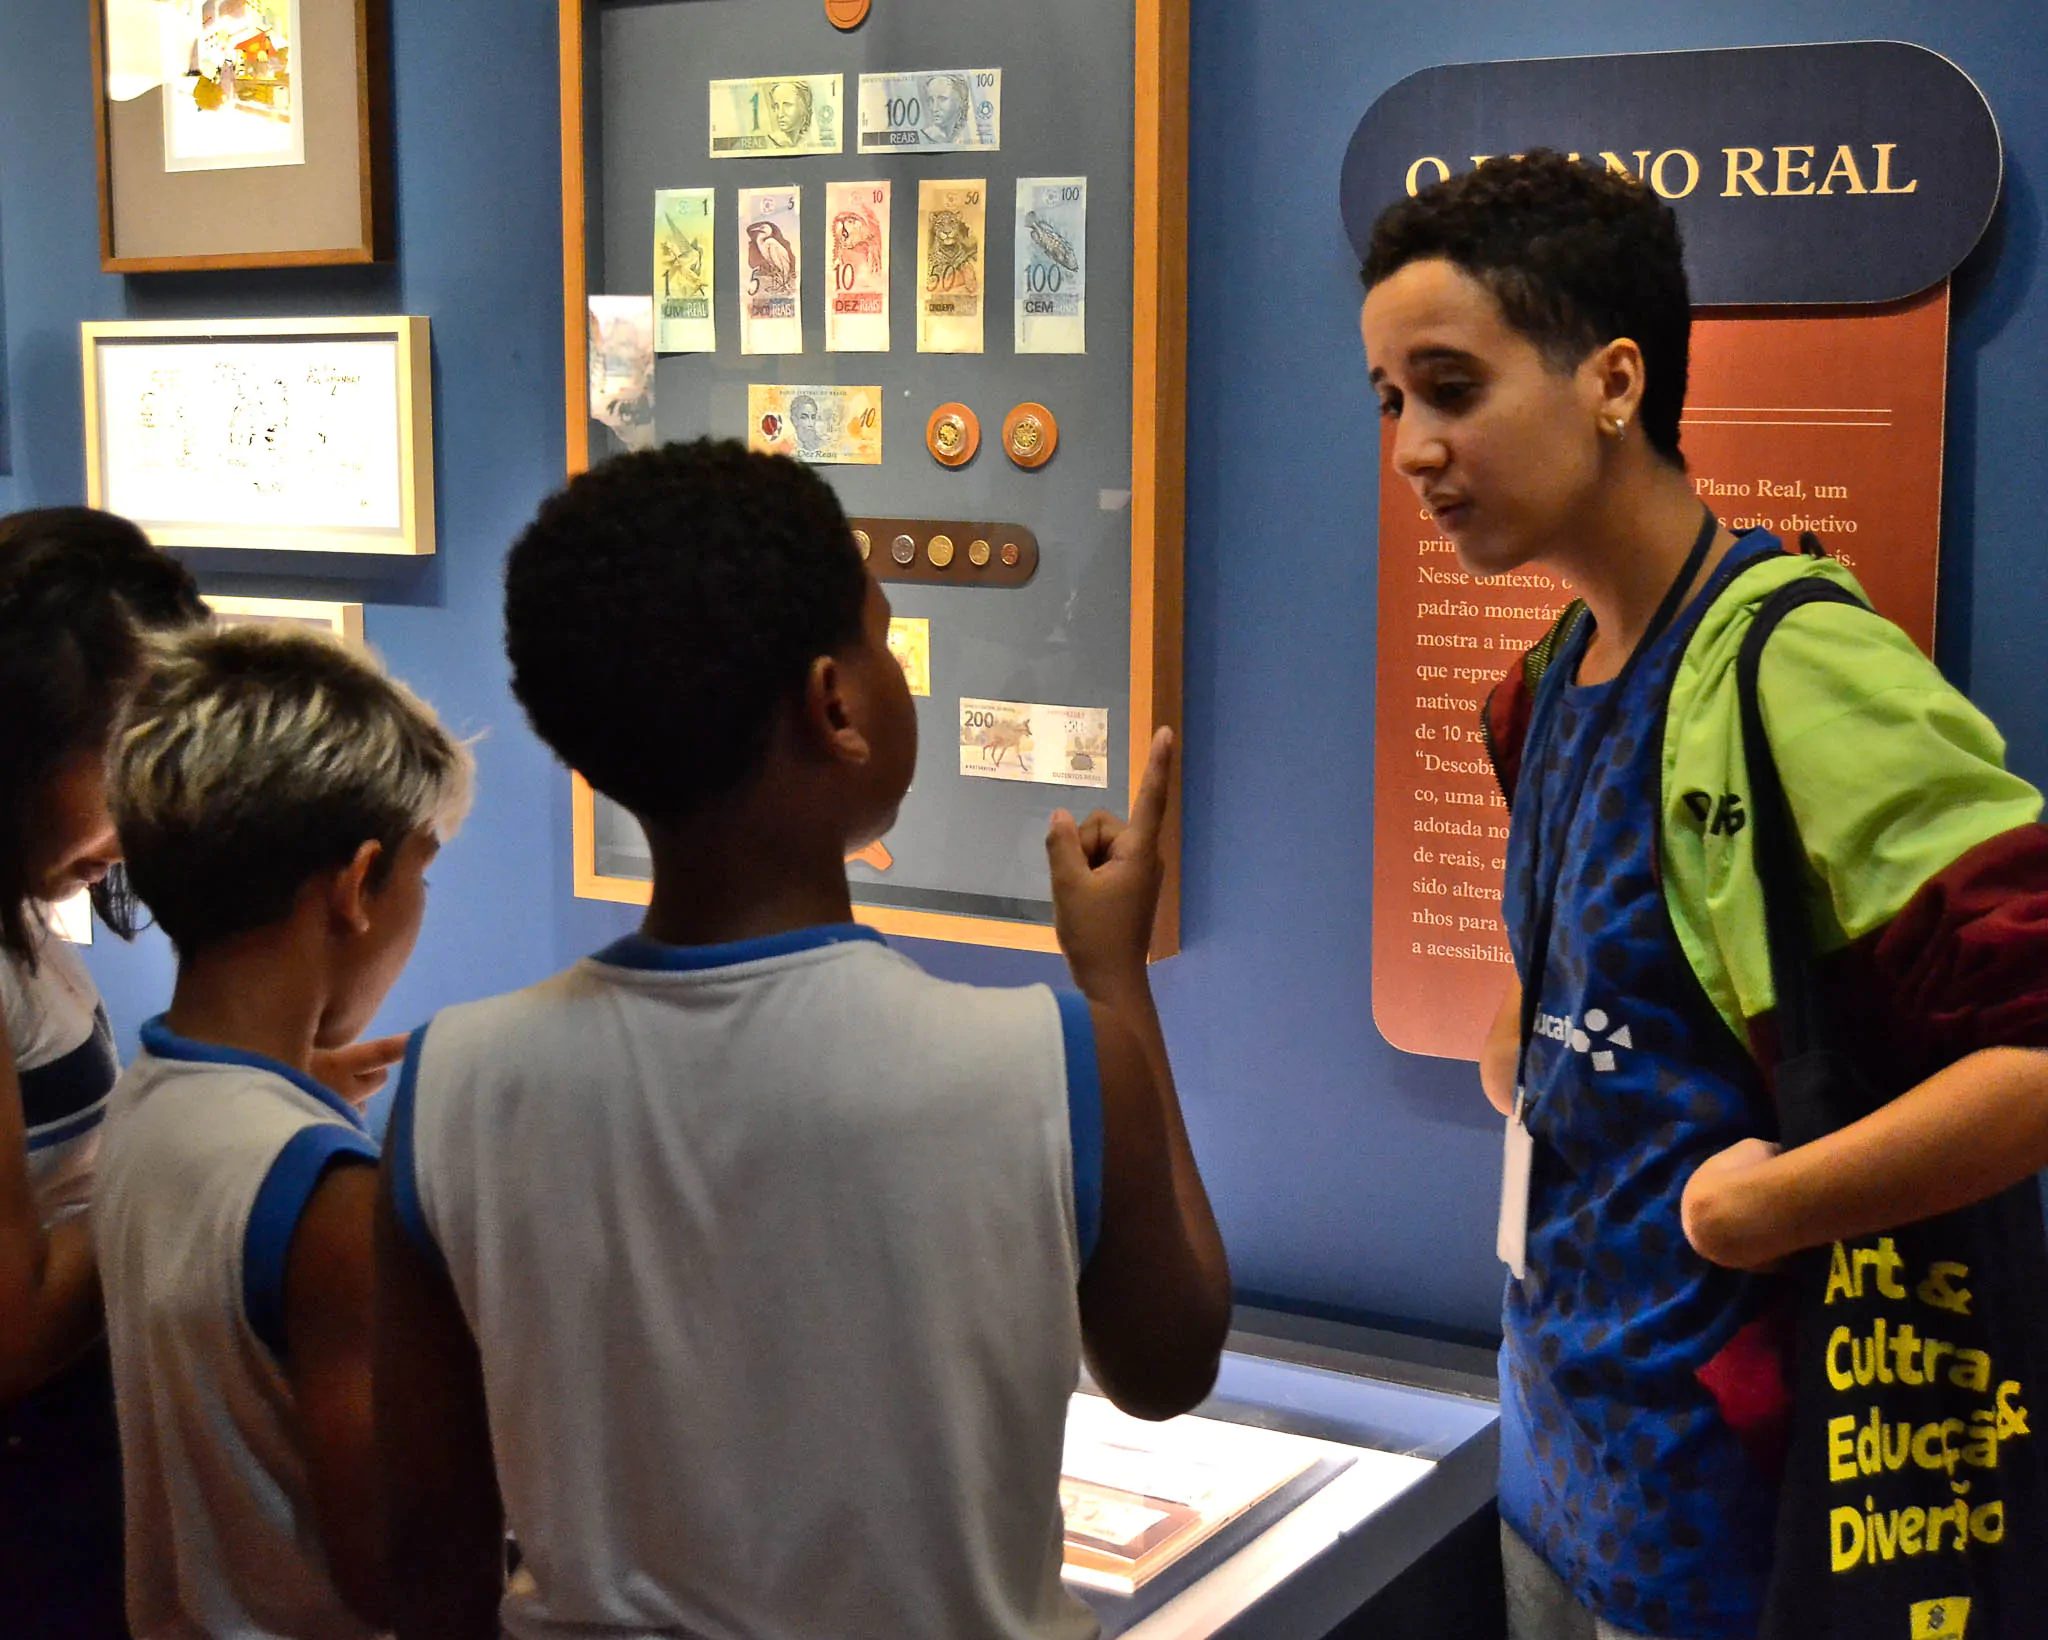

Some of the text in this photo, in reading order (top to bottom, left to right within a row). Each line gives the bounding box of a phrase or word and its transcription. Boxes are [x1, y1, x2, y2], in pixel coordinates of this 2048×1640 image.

[976, 73, 994, 88] 100
[749, 92, 760, 131] 1
[885, 97, 920, 127] 100
[889, 134, 916, 144] REAIS
[1719, 143, 1918, 197] REAL
[872, 190, 884, 204] 10
[964, 191, 980, 205] 50
[1061, 186, 1080, 201] 100
[833, 263, 855, 291] 10
[926, 263, 957, 293] 50
[1023, 263, 1062, 293] 100
[835, 300, 859, 311] DEZ
[1025, 300, 1054, 313] CEM
[859, 407, 876, 428] 10
[1695, 477, 1849, 501] Plano Real, um
[1418, 566, 1469, 585] Nesse
[1416, 599, 1479, 619] padrão
[1416, 633, 1478, 648] mostra
[1483, 637, 1494, 650] a
[1416, 664, 1449, 681] que
[1415, 693, 1478, 712] nativos
[963, 709, 994, 729] 200
[1415, 723, 1437, 740] de
[1442, 725, 1462, 742] 10
[1414, 788, 1439, 805] co,
[1444, 792, 1485, 806] uma
[1413, 817, 1483, 837] adotada
[1413, 846, 1435, 863] de
[1439, 851, 1486, 871] reais,
[1412, 876, 1448, 896] sido
[1411, 908, 1454, 927] nhos
[1459, 916, 1499, 932] para
[1411, 941, 1422, 954] a
[1824, 1236, 1908, 1305] Art
